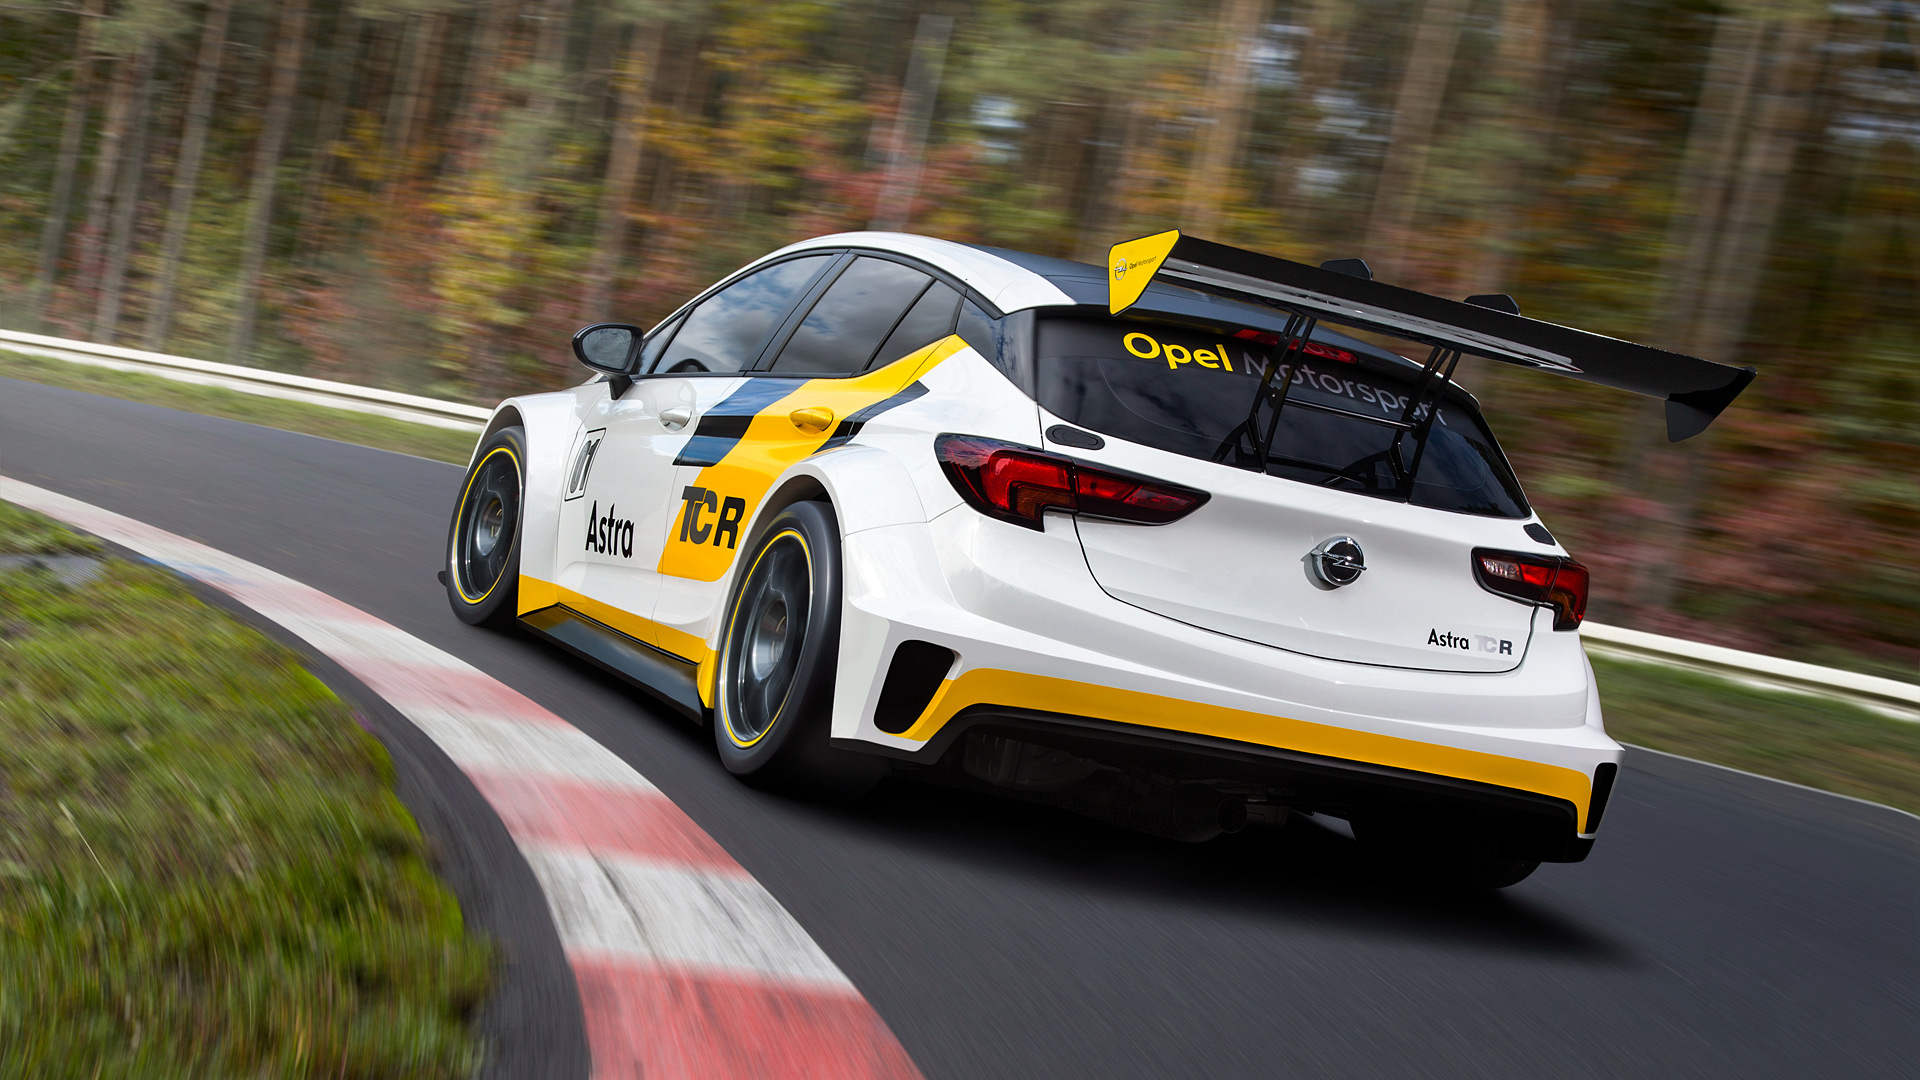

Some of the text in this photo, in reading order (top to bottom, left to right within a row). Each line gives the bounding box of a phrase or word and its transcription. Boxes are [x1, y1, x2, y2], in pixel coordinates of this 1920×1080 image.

[1123, 332, 1234, 372] Opel
[570, 438, 601, 494] 01
[585, 500, 635, 559] Astra
[679, 485, 746, 550] TCR
[1427, 628, 1513, 656] Astra TCR
